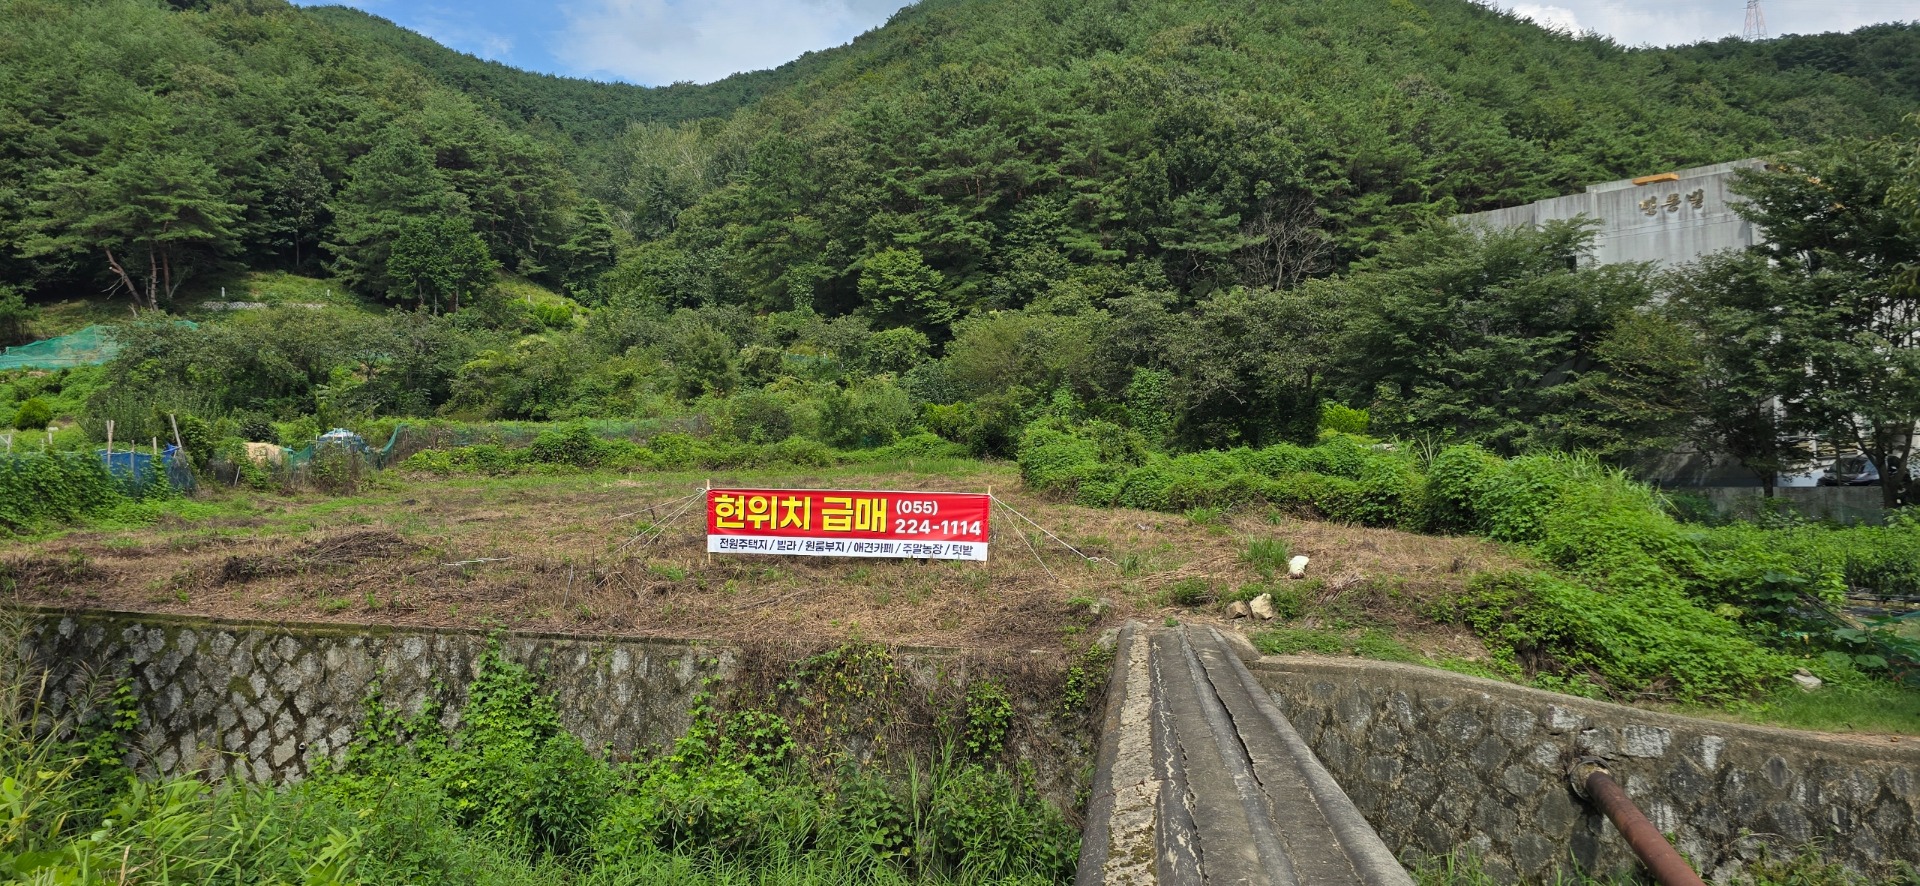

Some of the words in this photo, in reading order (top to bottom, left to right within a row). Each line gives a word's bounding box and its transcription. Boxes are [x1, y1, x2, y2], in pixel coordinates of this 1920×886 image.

[714, 494, 811, 530] 현위치
[821, 497, 887, 532] 급매
[896, 499, 938, 515] (055)
[895, 519, 981, 535] 224-1114
[719, 538, 767, 550] 전원주택지
[777, 540, 797, 551] 빌라
[805, 541, 844, 552] 원룸부지
[854, 542, 894, 554] 애견카페
[903, 543, 943, 555] 주말농장
[952, 544, 973, 556] 텃밭
